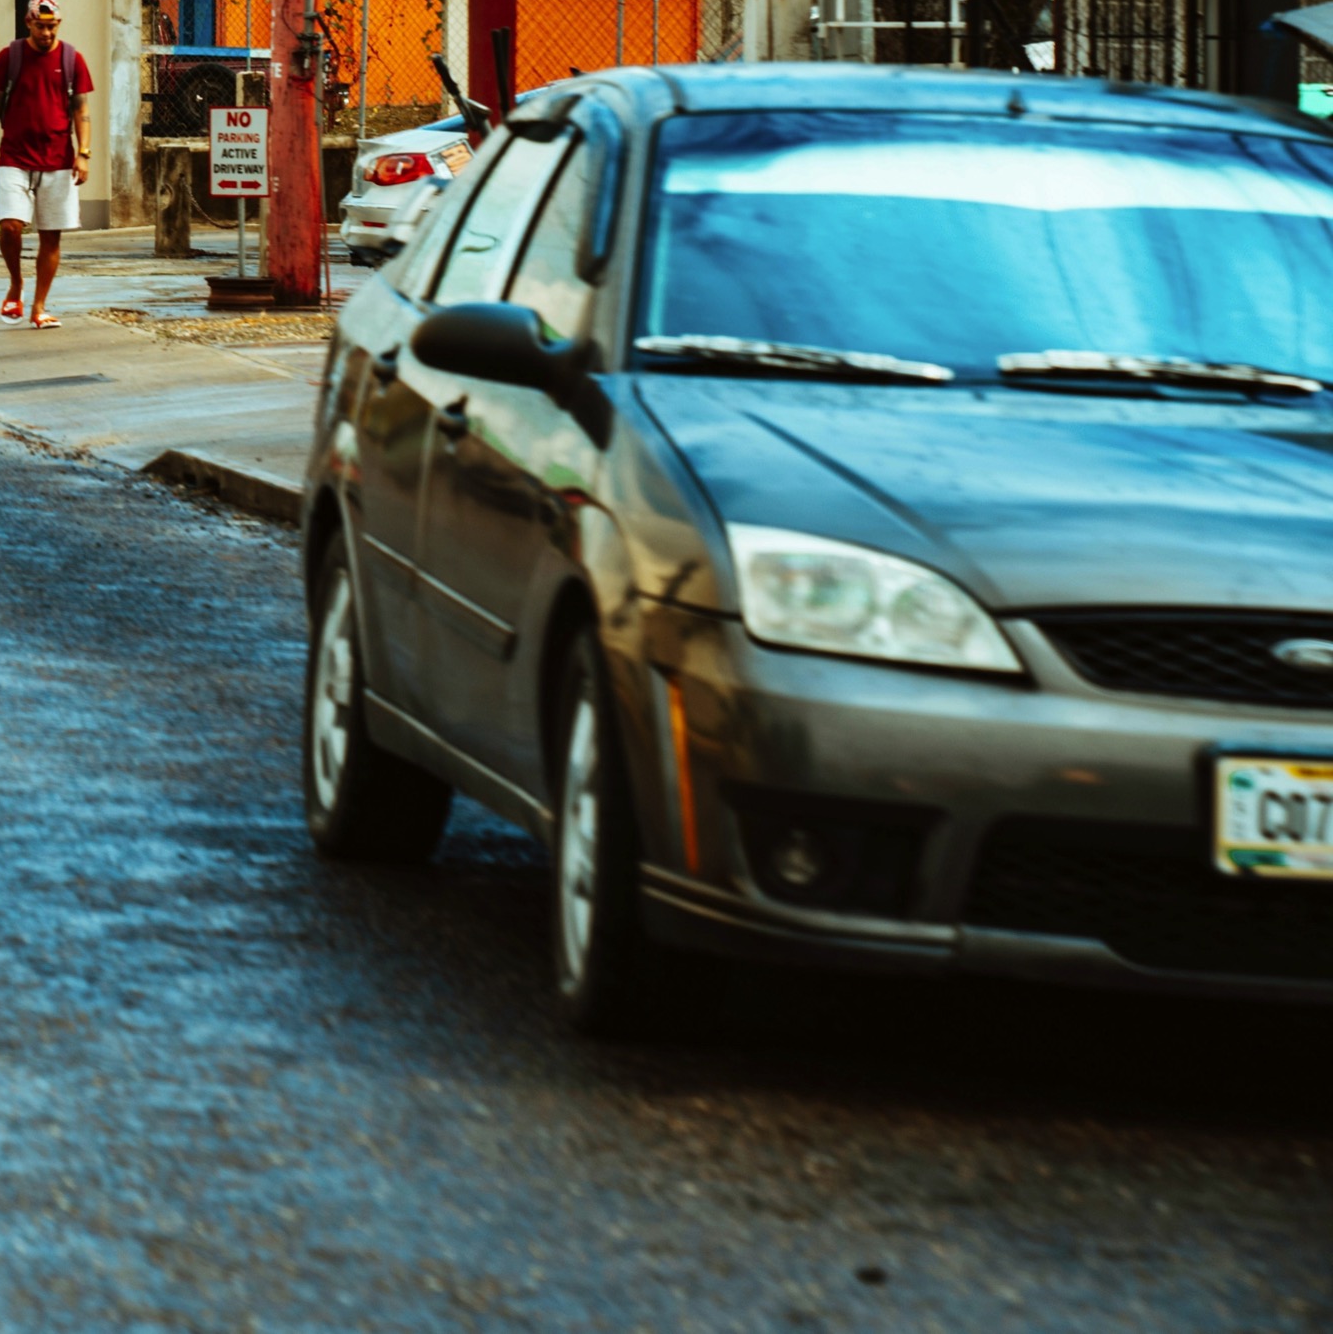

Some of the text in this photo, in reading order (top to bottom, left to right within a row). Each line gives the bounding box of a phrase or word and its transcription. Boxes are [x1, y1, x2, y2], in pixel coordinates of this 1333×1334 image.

[226, 111, 252, 128] NO
[217, 132, 261, 143] PARKING
[221, 148, 258, 159] ACTIVE
[213, 164, 265, 175] DRIVEWAY
